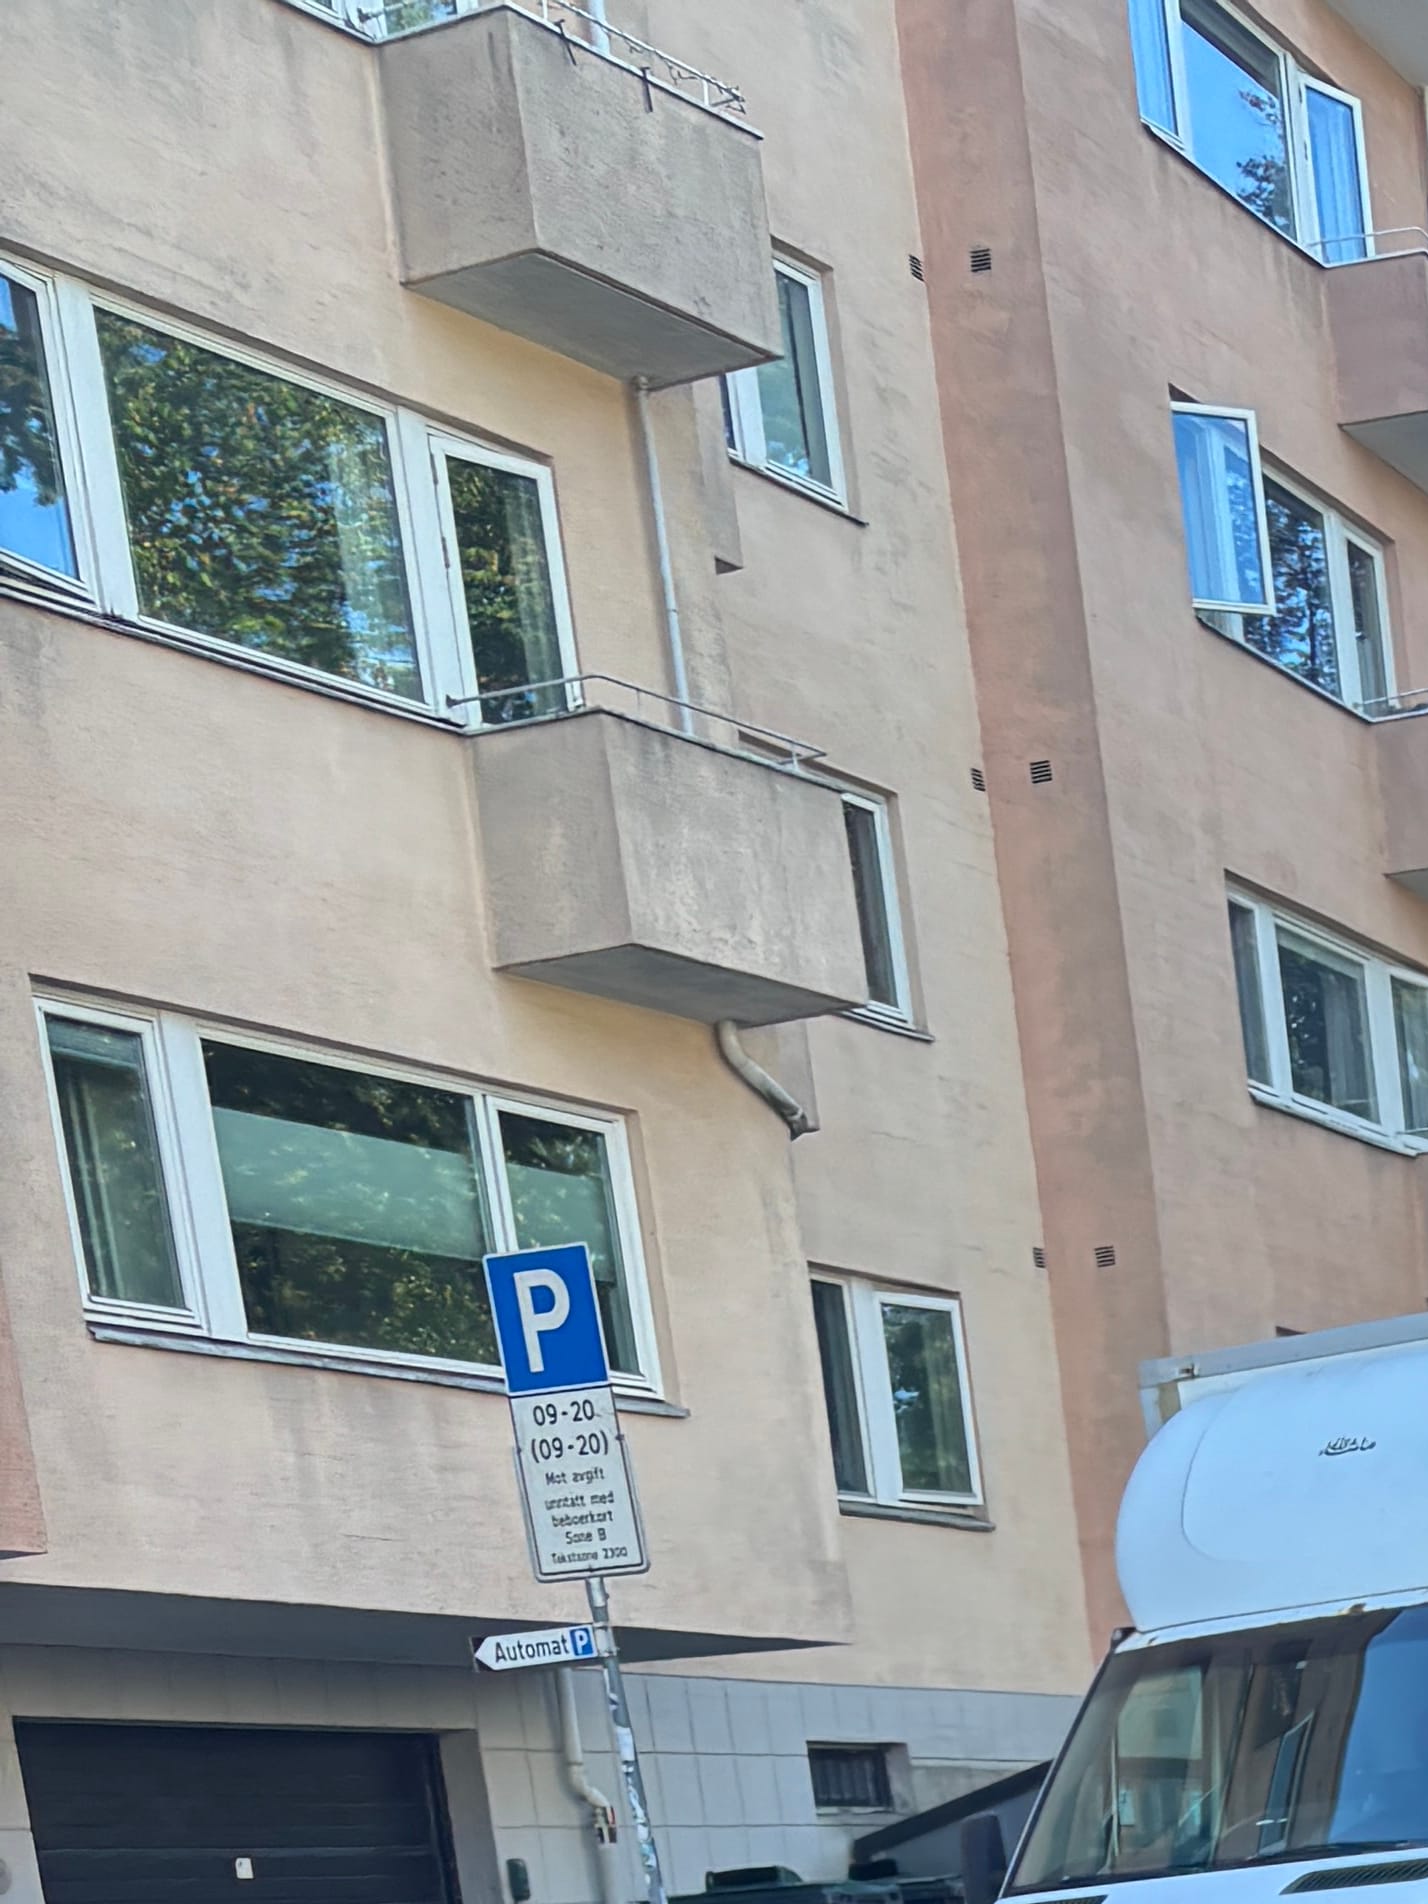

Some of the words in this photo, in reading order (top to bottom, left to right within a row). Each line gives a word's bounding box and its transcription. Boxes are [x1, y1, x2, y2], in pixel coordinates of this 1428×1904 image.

[513, 1268, 571, 1373] P
[495, 1635, 570, 1663] Automat
[574, 1630, 588, 1654] P
